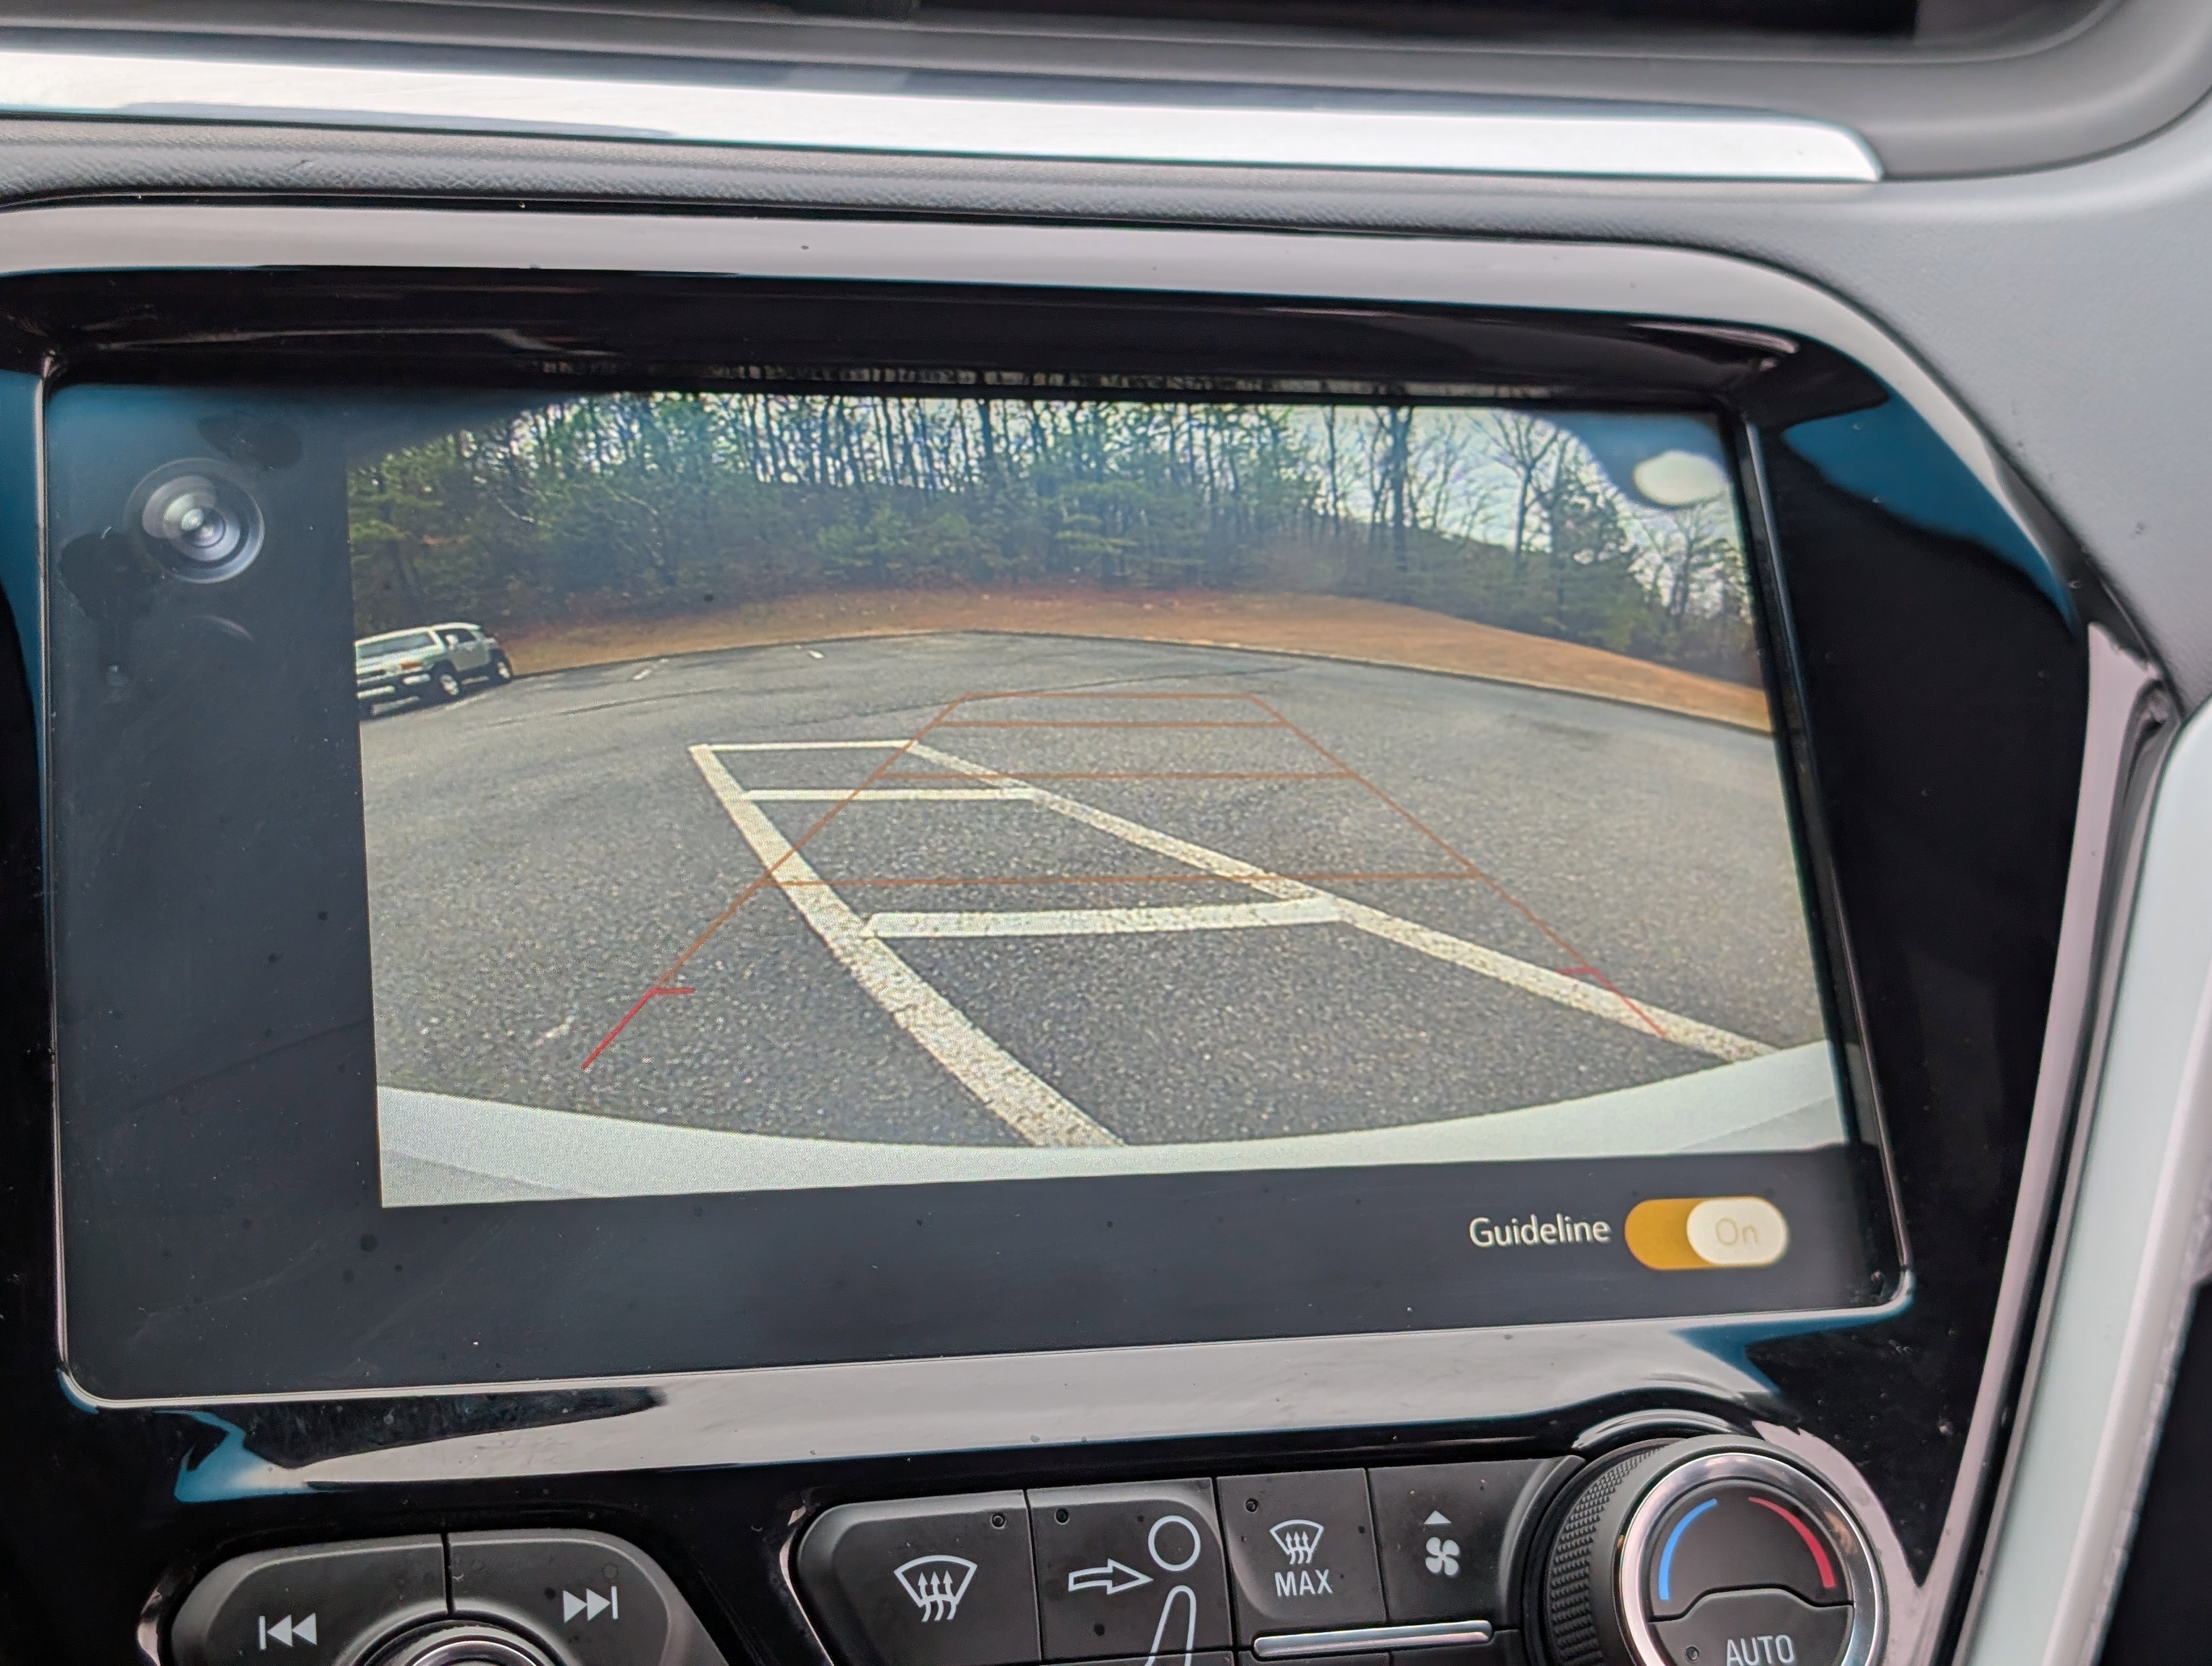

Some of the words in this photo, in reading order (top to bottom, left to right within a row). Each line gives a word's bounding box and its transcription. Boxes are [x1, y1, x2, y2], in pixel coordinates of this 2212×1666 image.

[1469, 1213, 1612, 1248] Guideline
[1714, 1218, 1758, 1247] On
[1274, 1568, 1334, 1597] MAX
[1726, 1634, 1795, 1666] AUTO
